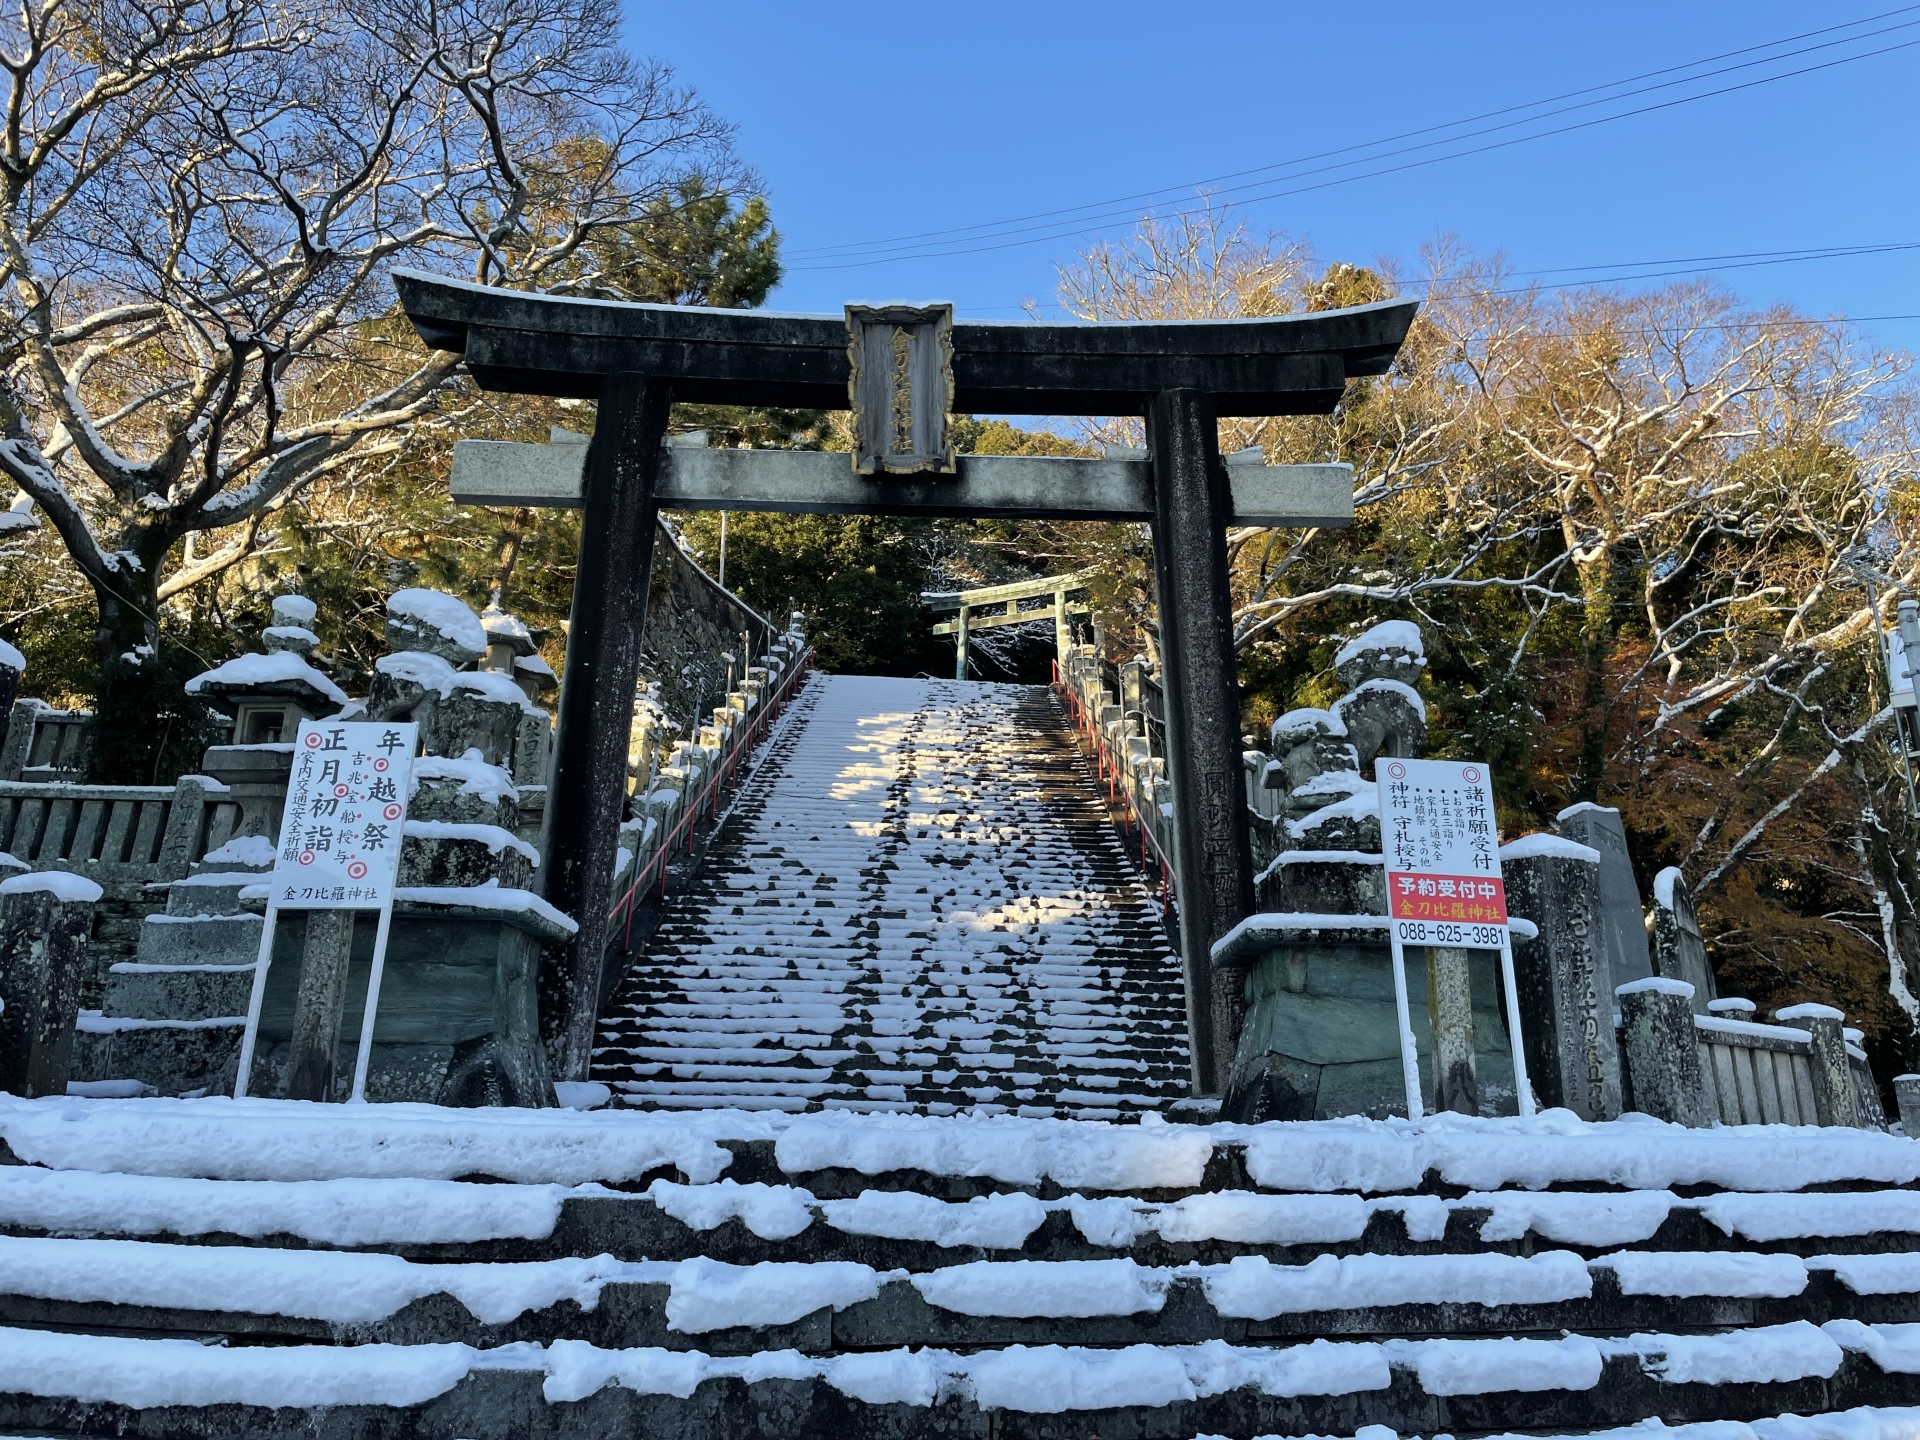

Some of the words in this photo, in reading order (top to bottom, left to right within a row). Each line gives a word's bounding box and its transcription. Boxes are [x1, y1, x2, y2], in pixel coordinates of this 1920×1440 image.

[887, 316, 916, 451] 金刀比羅神社
[282, 750, 316, 861] 家内交通安全祈願
[304, 728, 348, 852] 正月初詣
[334, 751, 366, 865] 吉兆宝船授与
[360, 729, 405, 851] 年越祭
[1453, 797, 1465, 839] お宮詣り
[1419, 836, 1432, 868] その他
[1426, 796, 1443, 861] 家内交通安全
[1439, 797, 1454, 849] 七五三詣り
[1463, 786, 1493, 870] 諸祈願受付
[282, 886, 378, 901] 金刀比羅神社
[1397, 877, 1497, 900] 予約受付中
[1398, 899, 1502, 921] 金刀比羅神社
[1399, 922, 1505, 945] 088-625-3981
